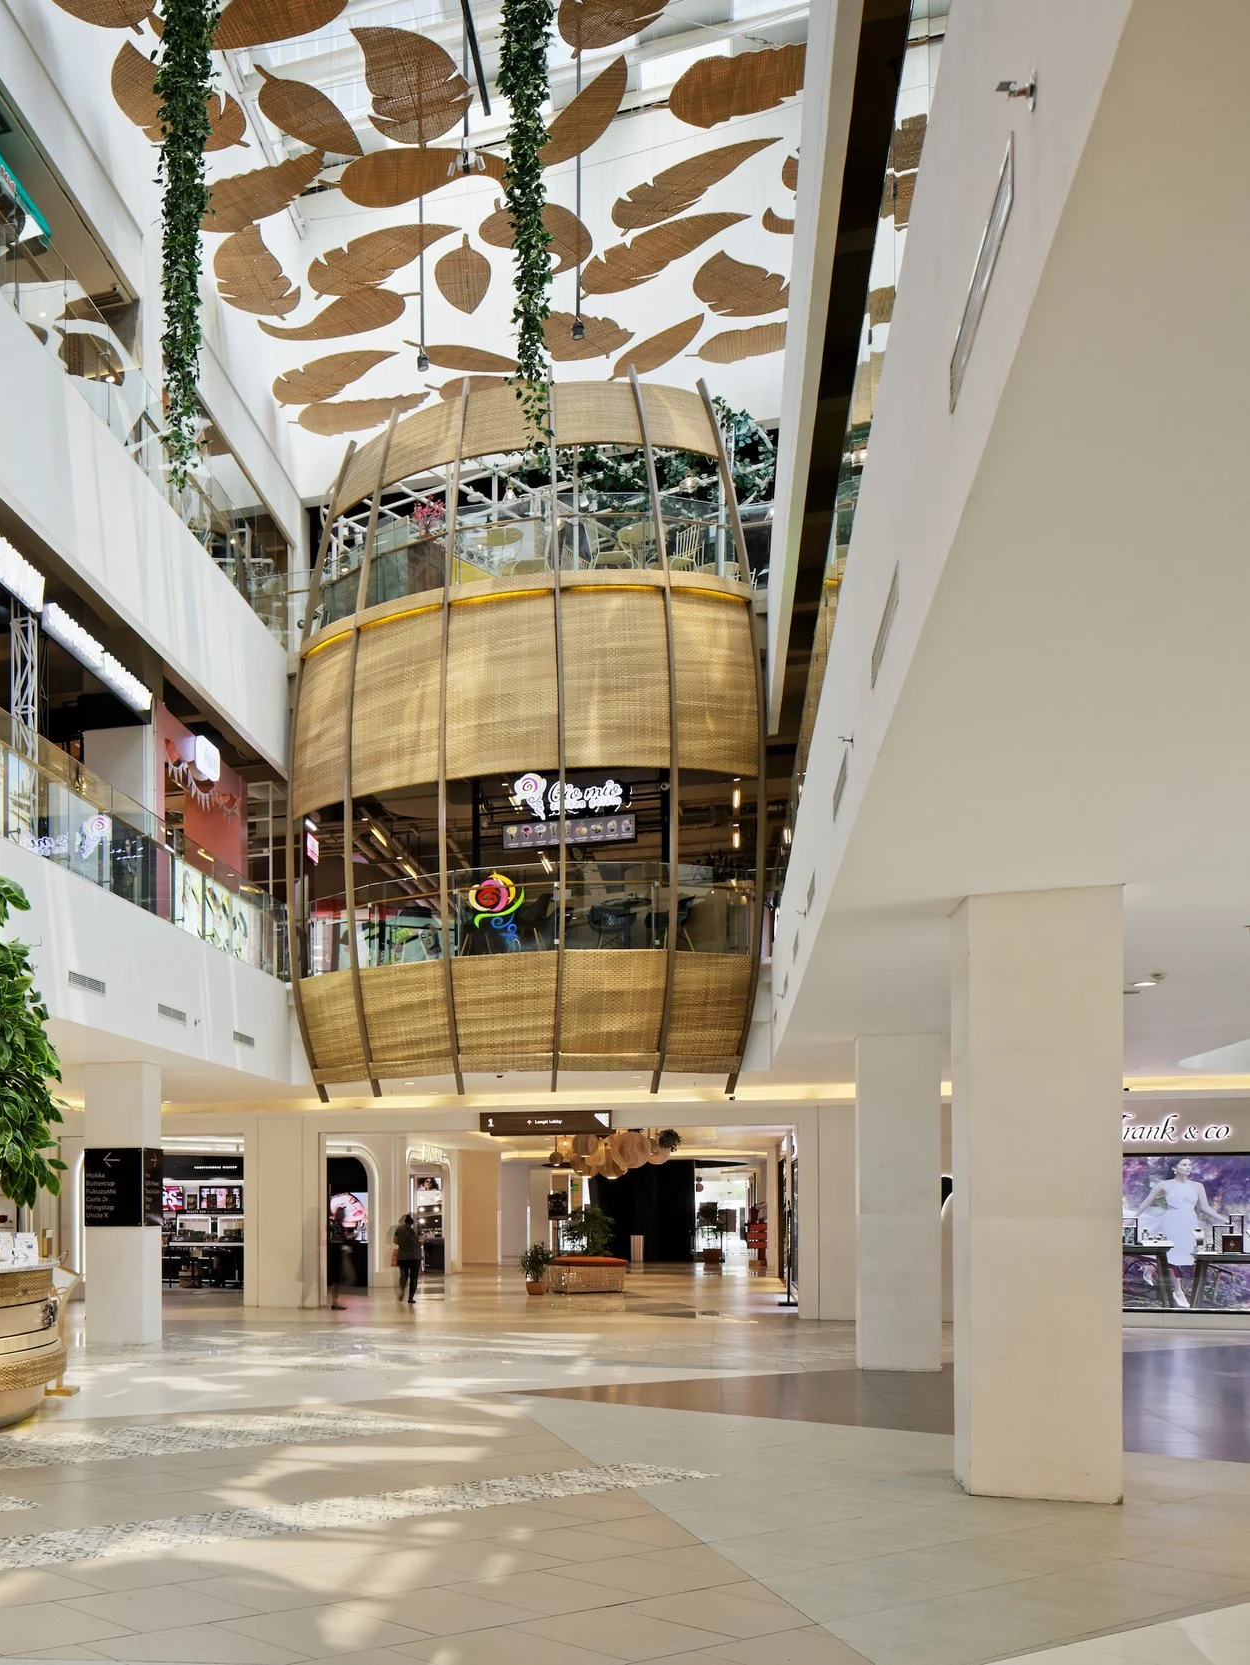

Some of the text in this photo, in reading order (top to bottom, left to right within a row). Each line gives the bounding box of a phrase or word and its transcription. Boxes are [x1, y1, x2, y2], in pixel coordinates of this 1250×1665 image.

[487, 1118, 494, 1127] 1
[1122, 1113, 1180, 1142] rank
[1184, 1125, 1200, 1140] &
[85, 1204, 115, 1212] Wingstop
